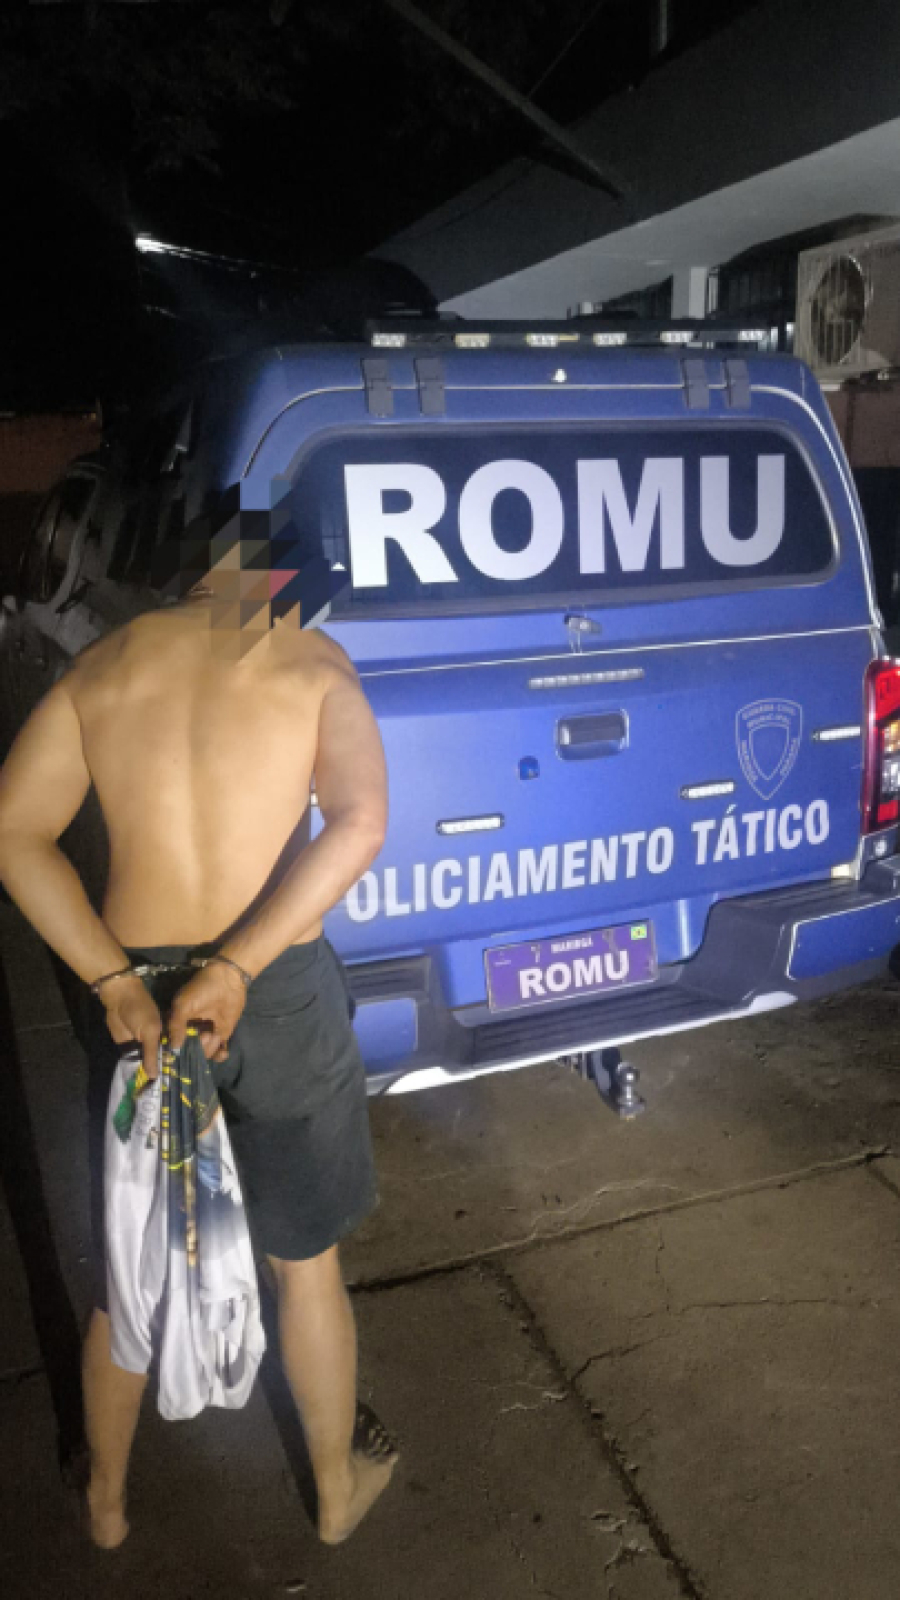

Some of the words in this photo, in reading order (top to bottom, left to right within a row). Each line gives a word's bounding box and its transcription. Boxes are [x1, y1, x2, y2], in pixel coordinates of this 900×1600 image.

[343, 453, 786, 588] ROMU
[345, 827, 674, 923] OLICIAMENTO
[691, 799, 830, 866] TÁTICO
[518, 950, 630, 999] ROMU
